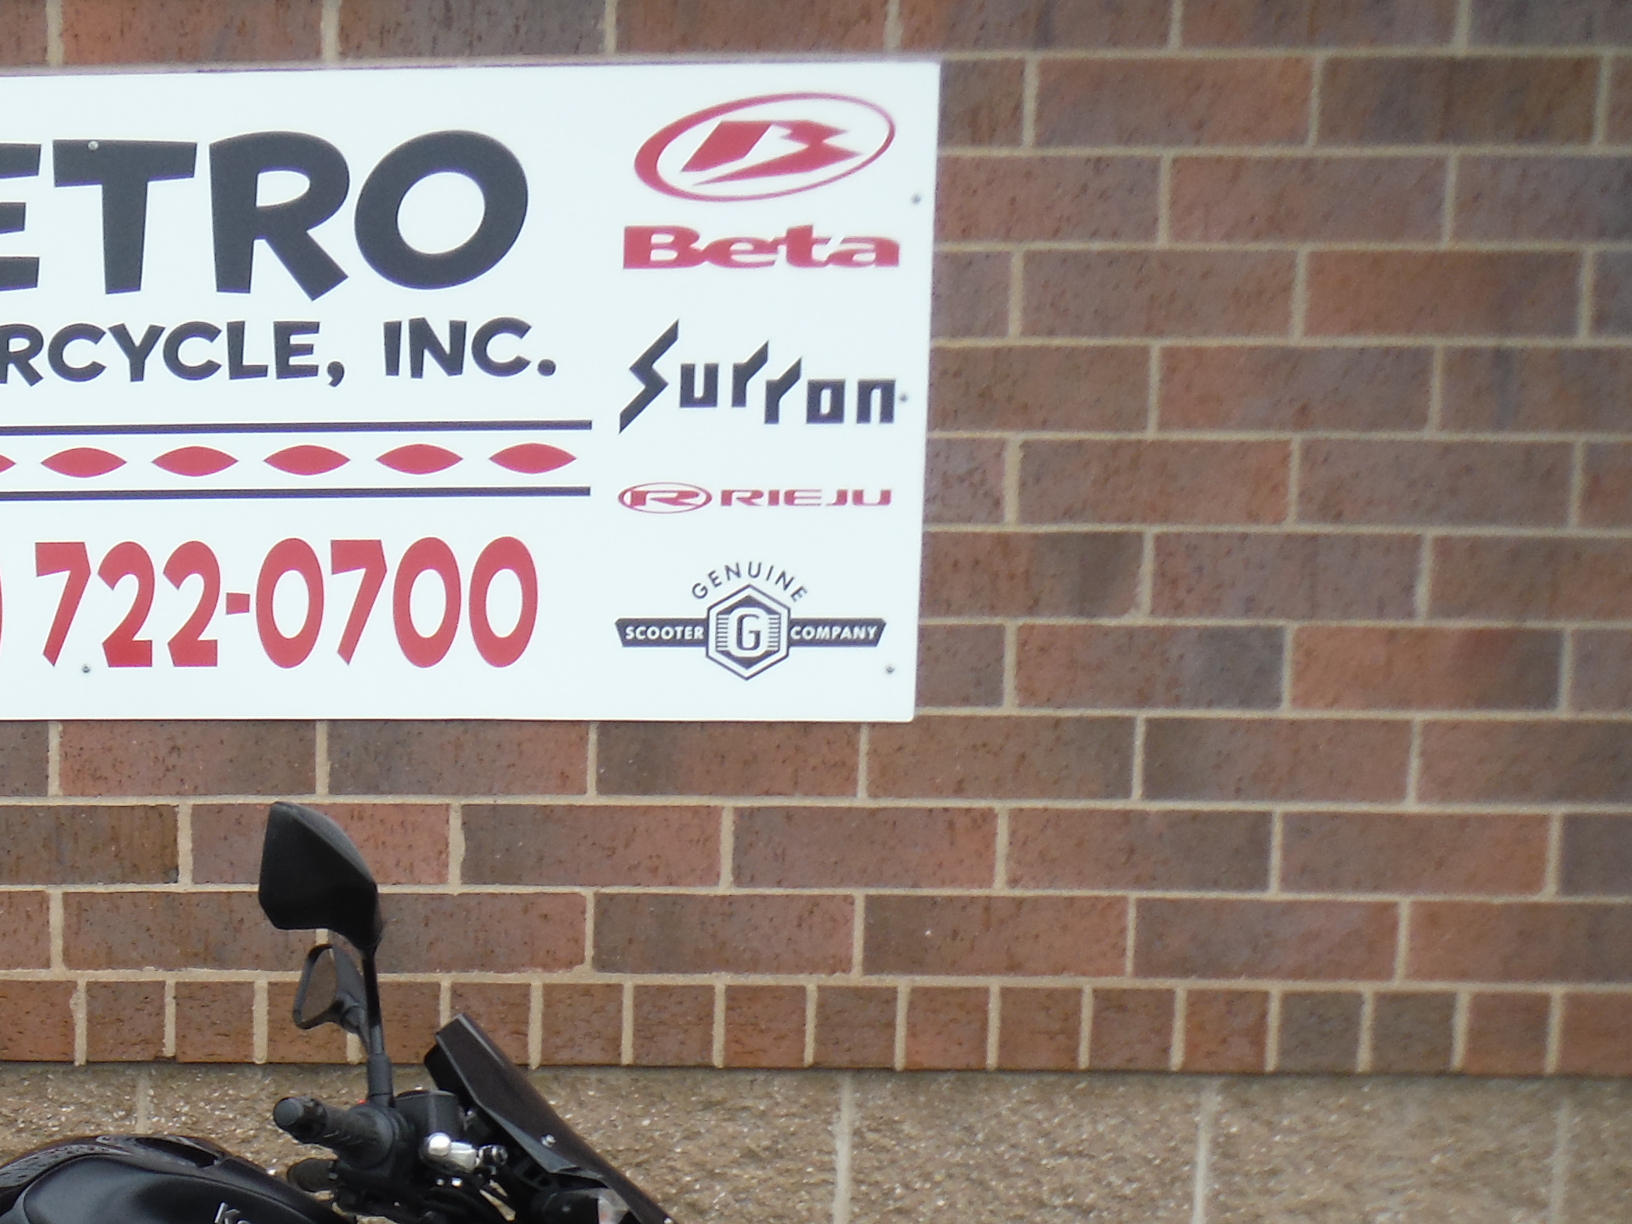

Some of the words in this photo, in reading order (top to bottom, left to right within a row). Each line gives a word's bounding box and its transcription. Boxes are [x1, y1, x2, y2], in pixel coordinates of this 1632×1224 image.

[624, 225, 899, 269] Beta
[384, 317, 557, 379] INC.
[619, 319, 896, 433] Surron
[721, 489, 892, 506] RIEJU
[35, 536, 538, 669] 722-0700
[691, 561, 808, 602] GENUINE
[625, 626, 704, 640] SCOOTER
[737, 613, 761, 651] G
[790, 626, 878, 641] COMPANY
